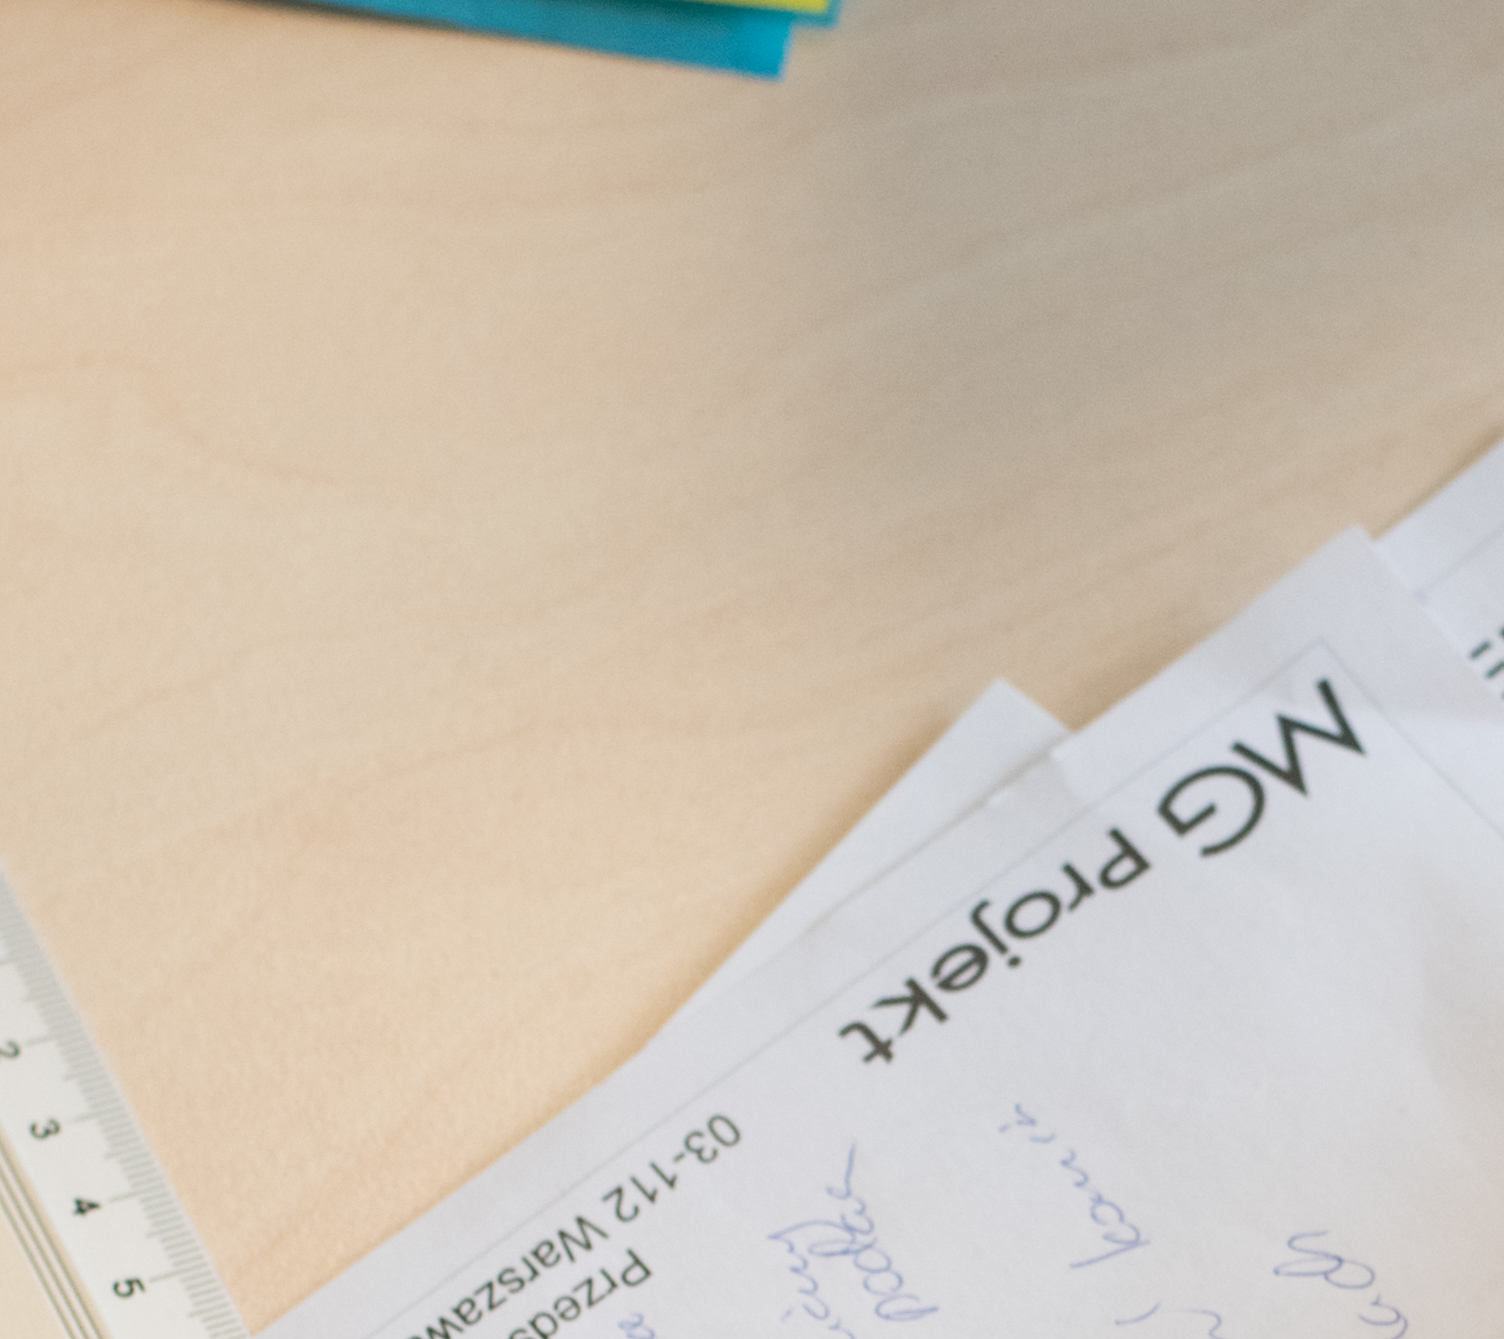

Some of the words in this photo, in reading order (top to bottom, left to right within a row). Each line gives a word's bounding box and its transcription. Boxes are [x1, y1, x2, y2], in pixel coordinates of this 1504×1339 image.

[1158, 678, 1368, 859] MG
[837, 827, 1153, 1066] Projekt
[601, 1113, 742, 1223] 03-112
